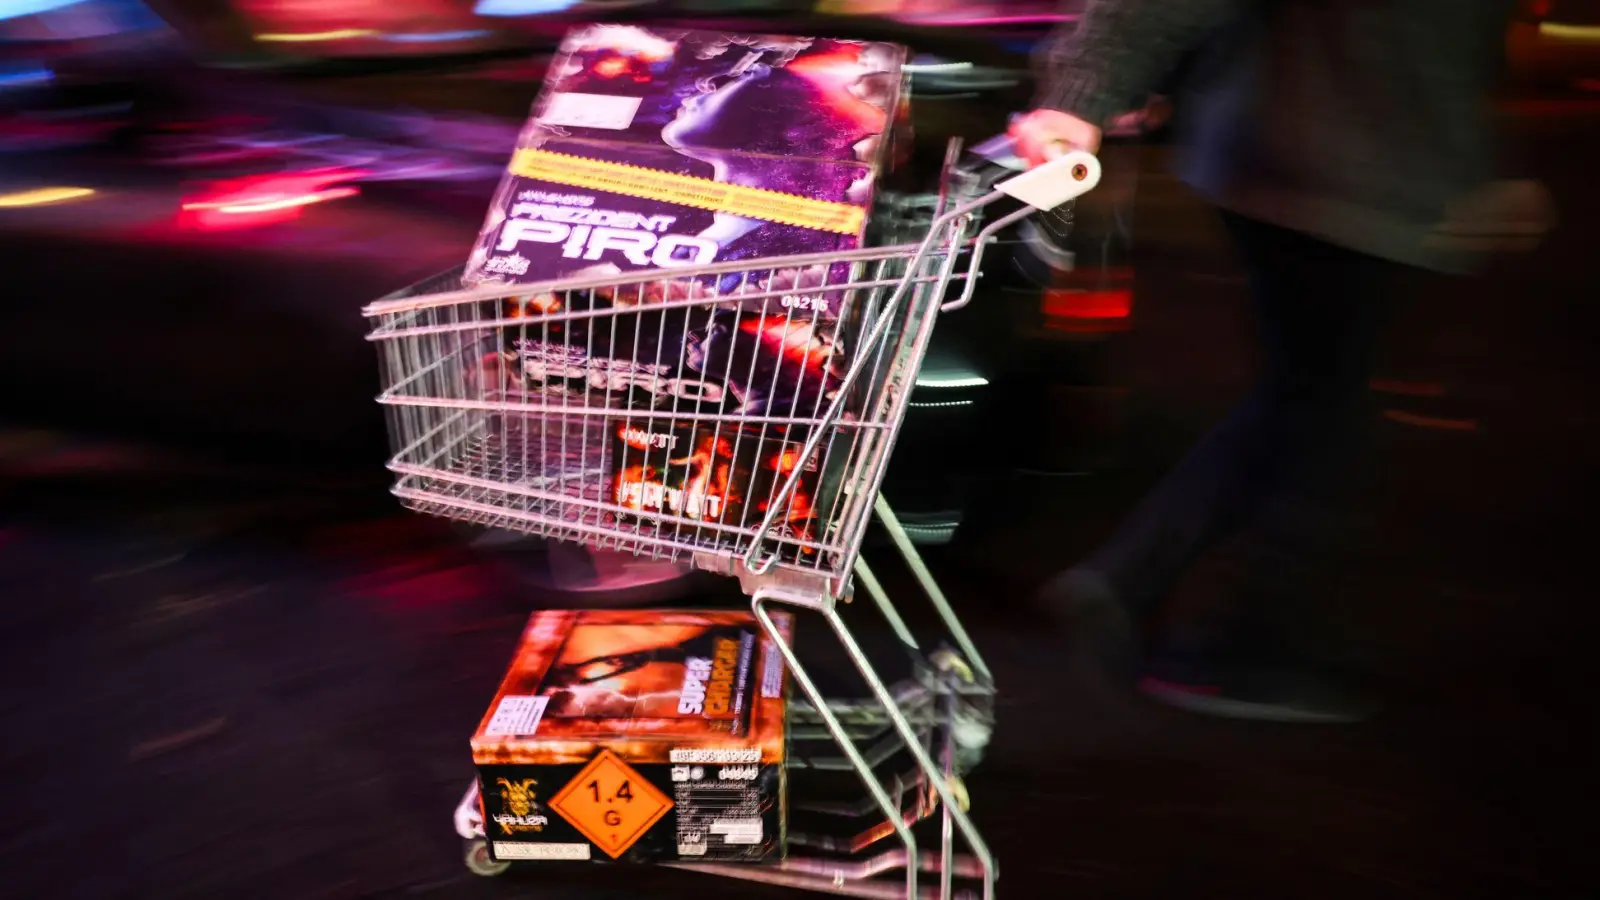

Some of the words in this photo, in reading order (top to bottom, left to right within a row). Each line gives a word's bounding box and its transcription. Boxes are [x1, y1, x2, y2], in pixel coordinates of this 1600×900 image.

[510, 201, 677, 232] PREZIDENT
[495, 217, 719, 269] PIRO
[677, 656, 714, 714] SUPER
[587, 779, 634, 805] 1.4
[604, 809, 621, 826] G
